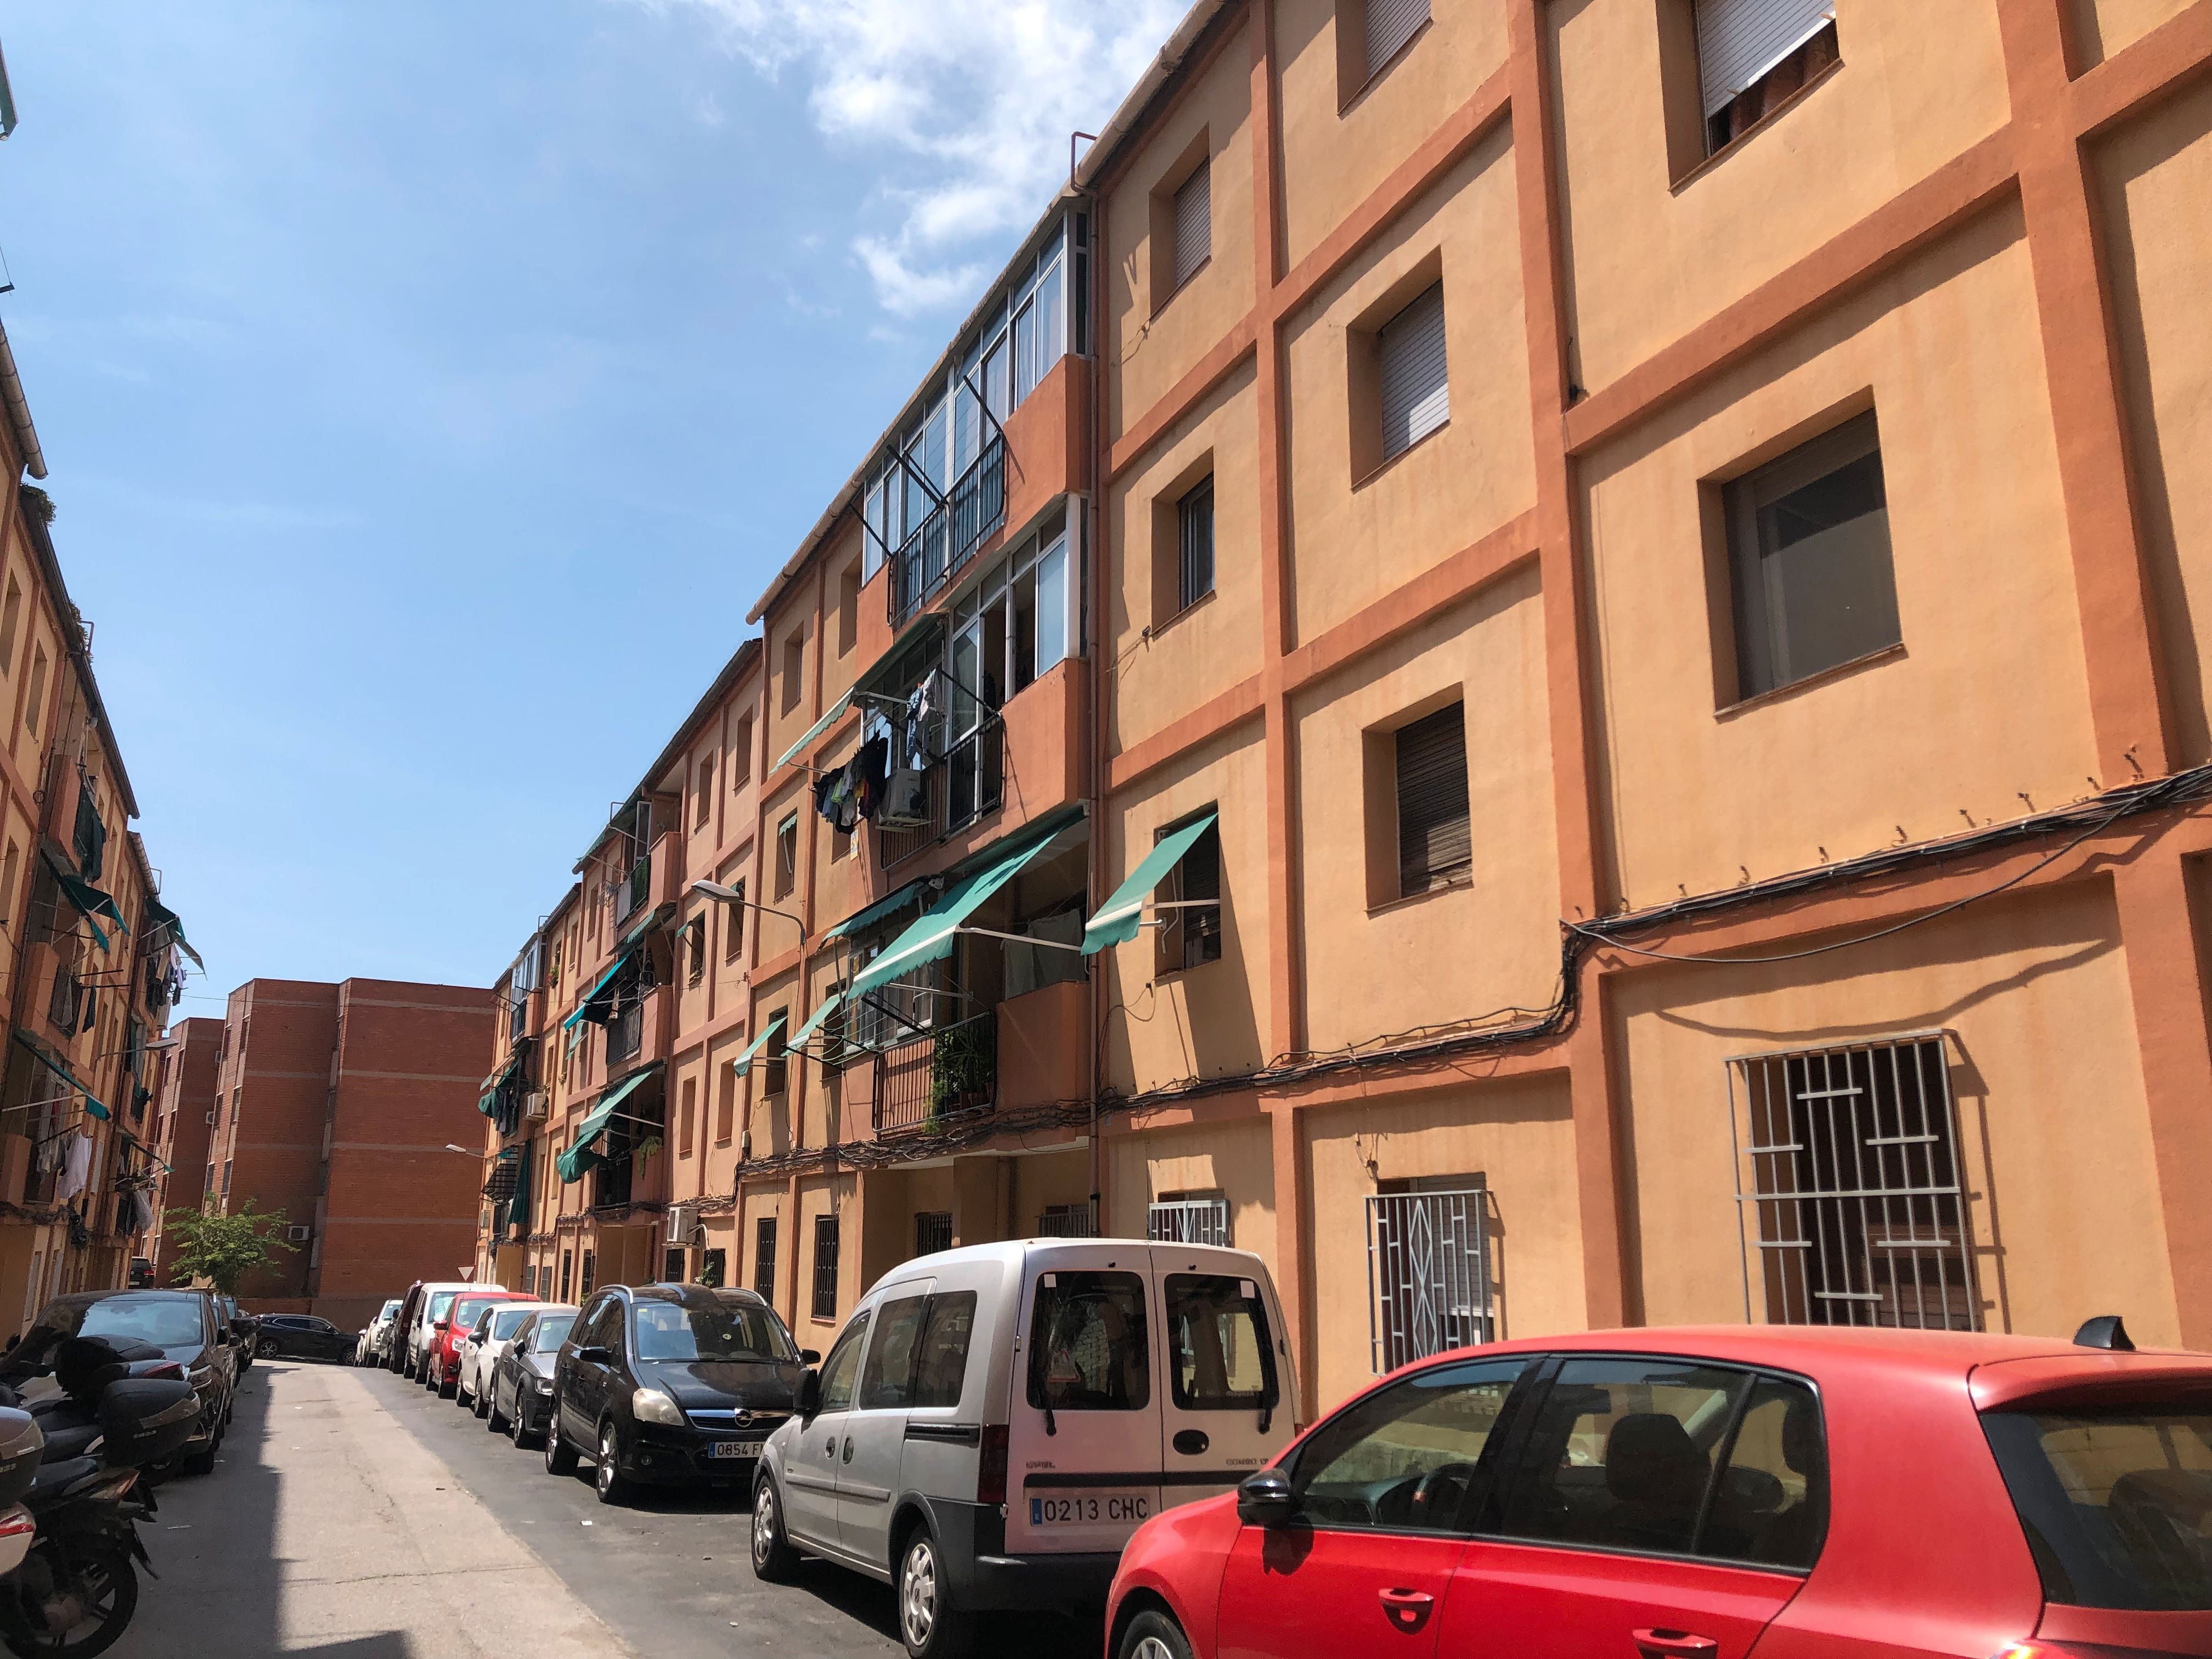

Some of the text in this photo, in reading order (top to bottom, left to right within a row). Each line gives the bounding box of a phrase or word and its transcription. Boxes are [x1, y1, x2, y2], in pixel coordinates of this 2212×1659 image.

[717, 1444, 748, 1455] 0854
[1044, 1498, 1148, 1522] 0213 CHC
